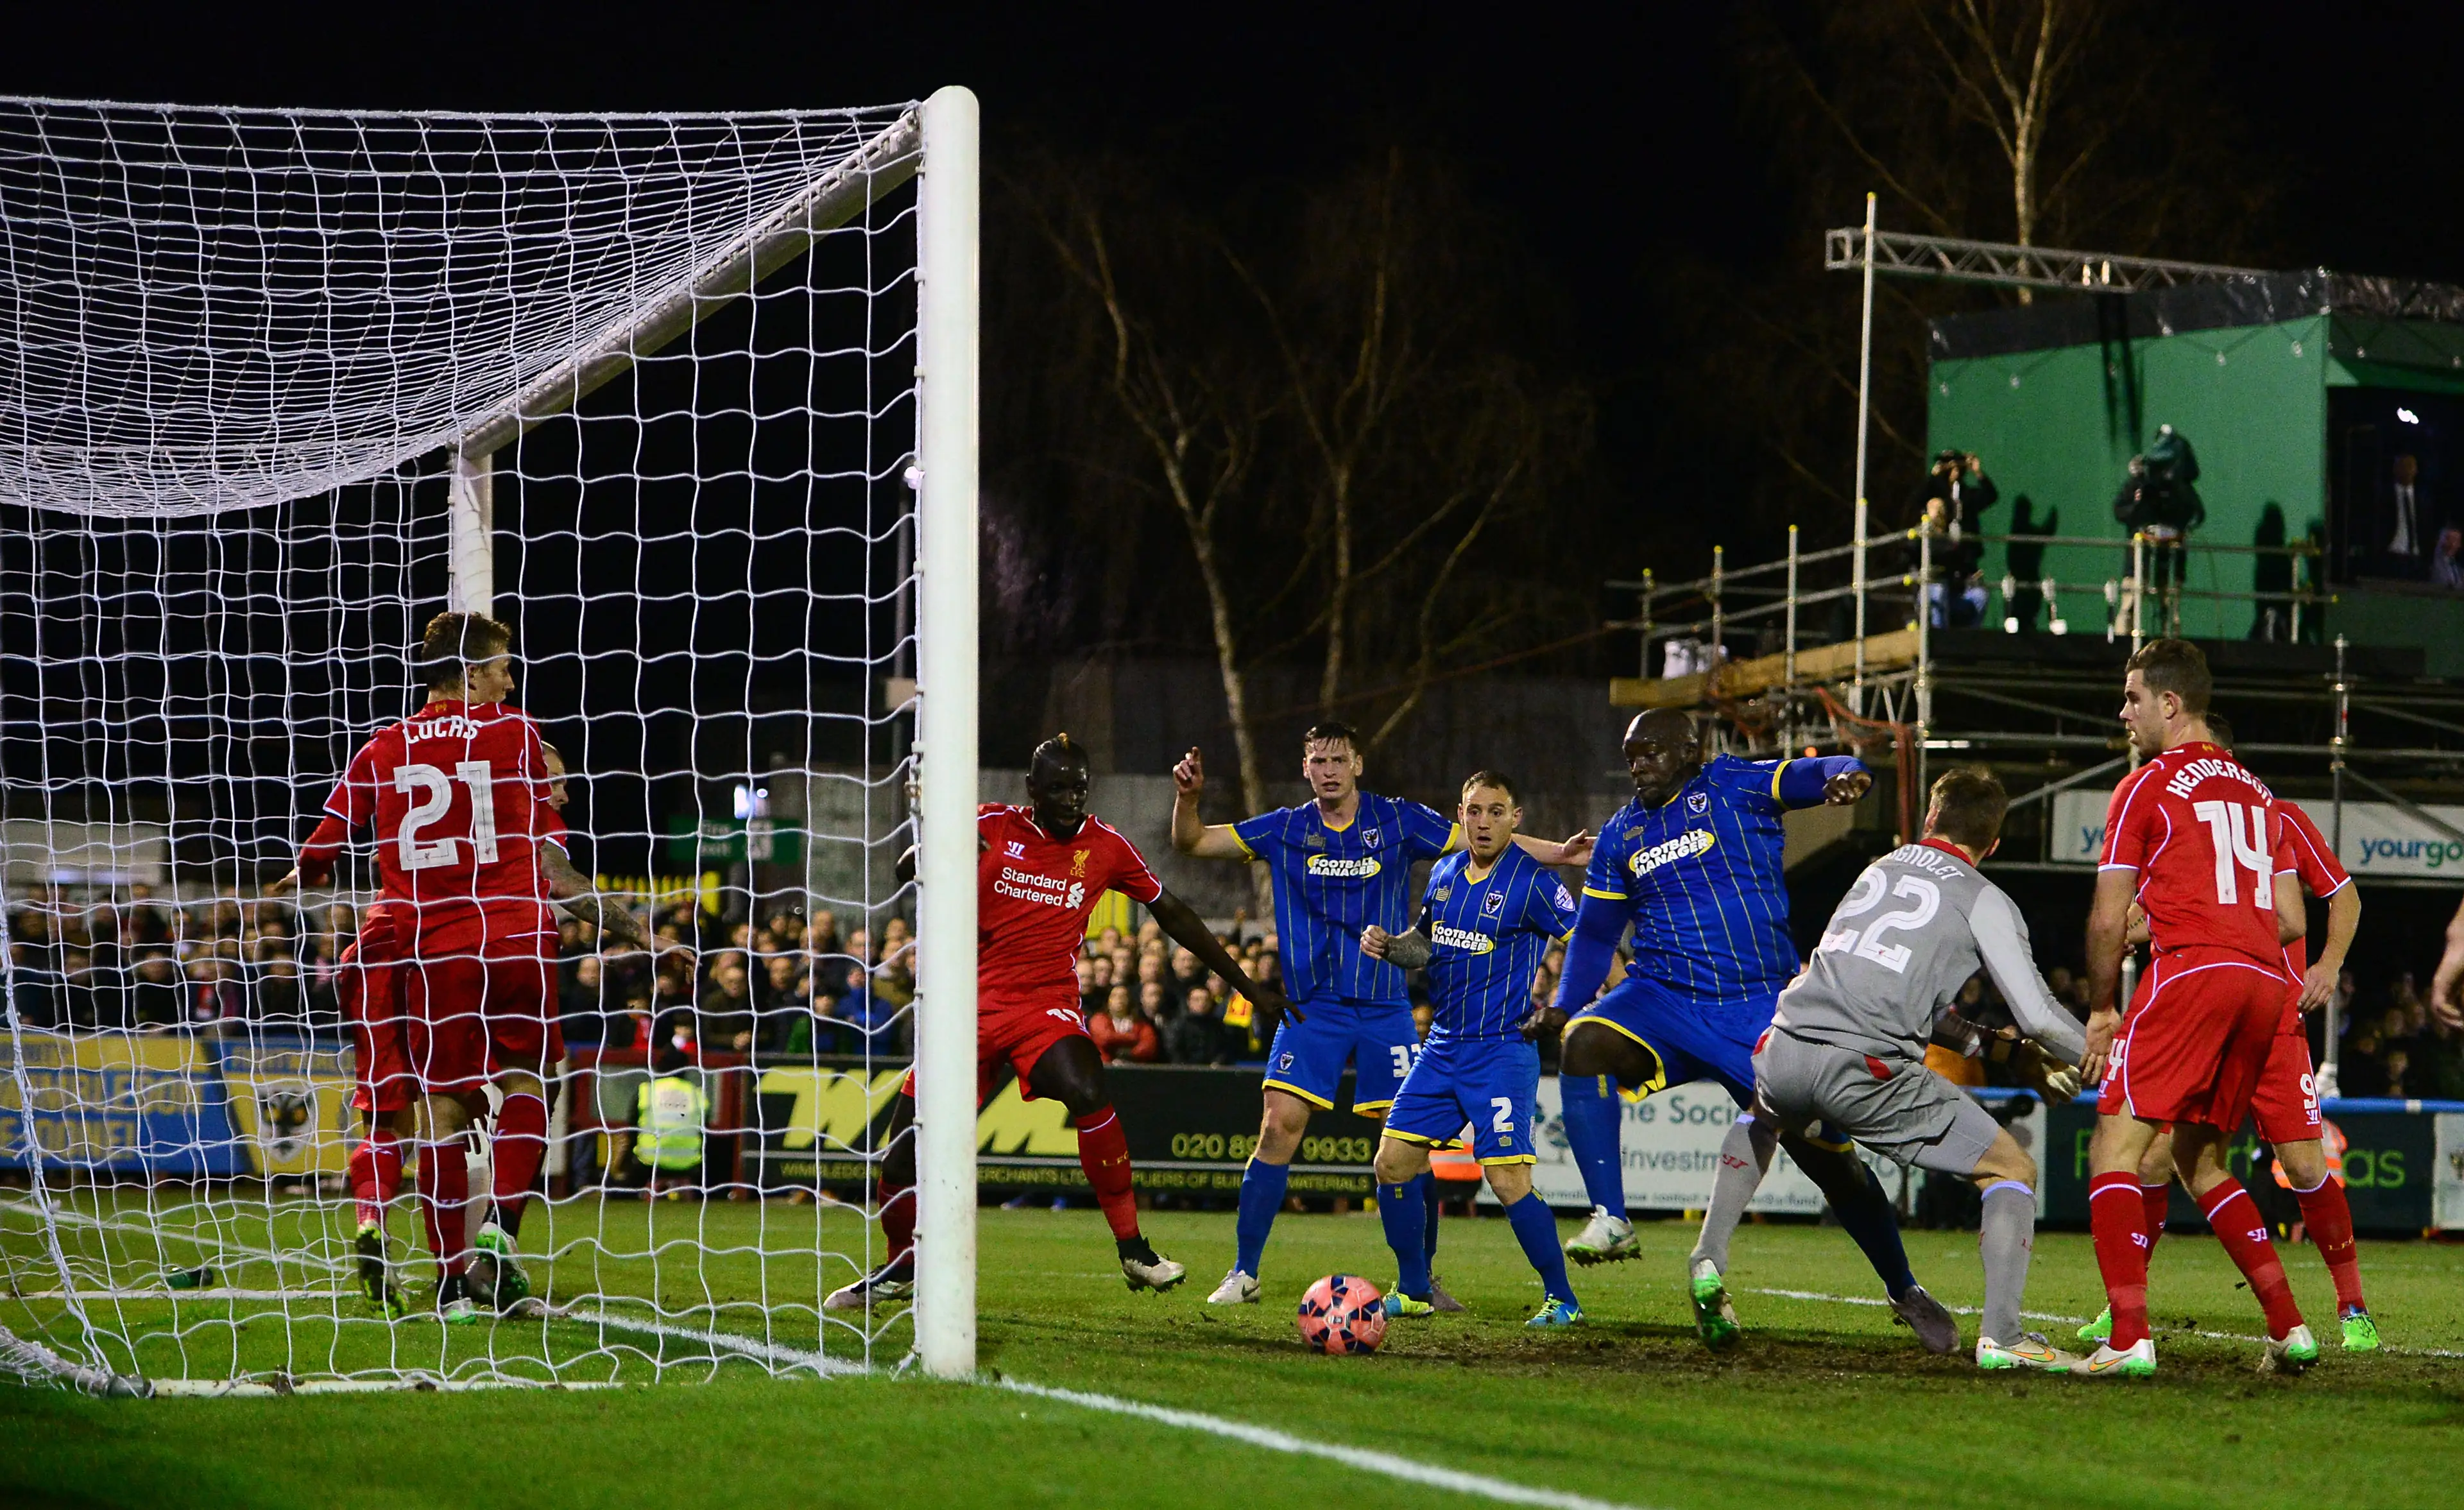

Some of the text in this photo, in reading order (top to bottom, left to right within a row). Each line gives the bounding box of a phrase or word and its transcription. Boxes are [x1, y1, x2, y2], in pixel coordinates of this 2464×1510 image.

[402, 715, 483, 744] LUCAS
[393, 760, 499, 871] 21
[1633, 828, 1707, 866] FOOTBALL
[1635, 837, 1708, 879] MANAGER
[2193, 800, 2273, 910] 14
[1070, 869, 1086, 878] LFC
[1309, 865, 1376, 877] MANAGER
[1313, 857, 1374, 869] FOOTBALL
[994, 880, 1063, 906] Chartered
[1002, 867, 1067, 891] Standard
[1433, 925, 1489, 943] FOOTBALL
[1819, 866, 1940, 974] 22
[1432, 933, 1487, 951] MANAGER
[2300, 1074, 2317, 1110] 9
[1491, 1096, 1514, 1133] 2
[1171, 1133, 1372, 1163] 020 89 9933
[1621, 1146, 1720, 1172] investm
[780, 1162, 882, 1180] WIMBLEDON
[977, 1166, 1057, 1184] ERCHANTS
[1131, 1171, 1185, 1188] PLIERS
[1187, 1171, 1210, 1188] OF
[1287, 1174, 1370, 1192] MATERIALS
